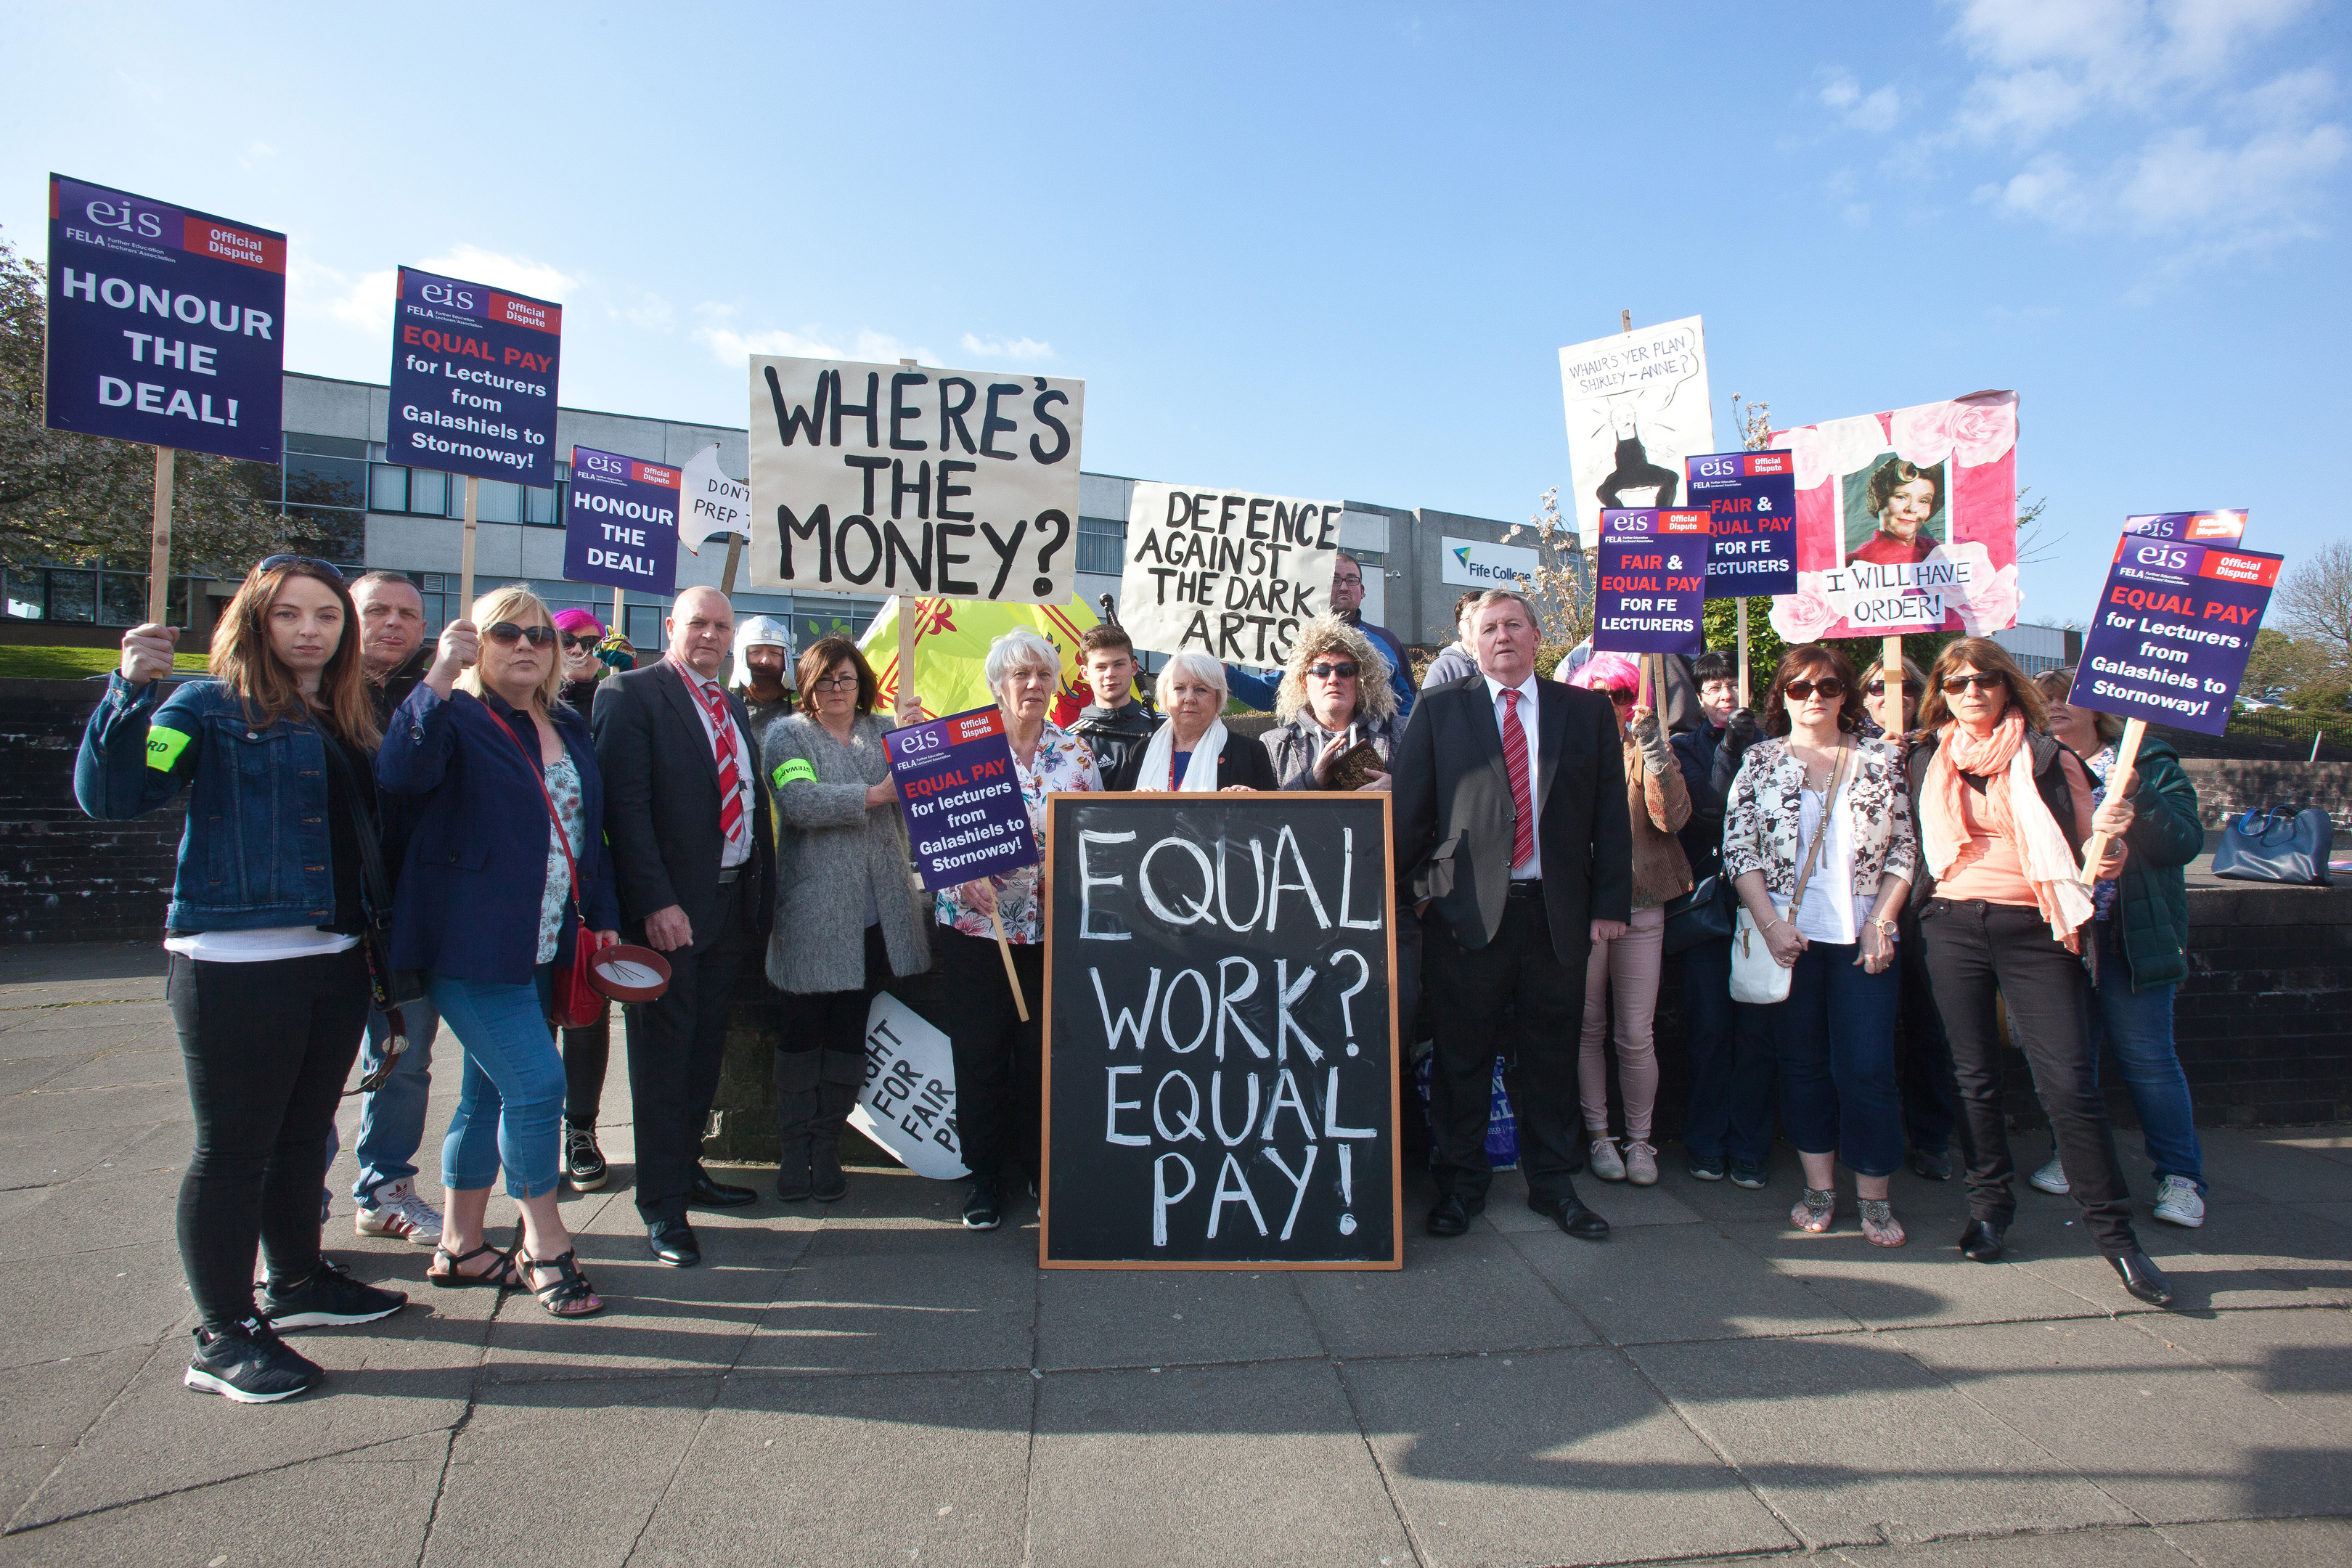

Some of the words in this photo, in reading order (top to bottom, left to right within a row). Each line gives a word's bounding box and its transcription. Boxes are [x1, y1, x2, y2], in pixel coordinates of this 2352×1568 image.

[86, 201, 162, 237] eis
[66, 227, 105, 246] FELA
[107, 237, 130, 246] Further
[132, 242, 164, 254] Education
[211, 229, 262, 251] Official
[139, 250, 176, 263] Association
[209, 240, 263, 264] Dispute
[63, 267, 272, 340] HONOUR
[422, 283, 473, 310] eis
[407, 305, 433, 318] FELA
[507, 310, 545, 327] Dispute
[508, 301, 544, 318] Official
[123, 330, 217, 376] THE
[404, 325, 495, 362] EQUAL
[505, 347, 552, 373] PAY
[1569, 354, 1619, 379] WHAUR'S
[1621, 346, 1649, 364] YER
[1653, 336, 1686, 357] PLAN
[407, 355, 438, 374] for
[445, 362, 547, 397] Lecturers
[99, 375, 238, 427] DEAL!
[452, 388, 502, 412] from
[402, 405, 518, 441] Galashiels
[524, 428, 544, 445] to
[764, 366, 1071, 465] WHERE'S
[412, 433, 534, 469] Stornoway!
[578, 471, 595, 480] FELA
[587, 456, 622, 474] eis
[644, 467, 669, 478] Official
[1700, 458, 1734, 476] eis
[1755, 464, 1782, 473] Dispute
[643, 473, 669, 485] Dispute
[709, 479, 749, 502] DON'T
[844, 454, 976, 522] THE
[574, 491, 674, 526] HONOUR
[694, 499, 738, 523] PREP
[1711, 498, 1752, 514] FAIR
[1757, 497, 1772, 512] &
[1166, 491, 1342, 550] DEFENCE
[1614, 513, 1648, 531] eis
[1708, 520, 1753, 537] QUAL
[1758, 516, 1792, 533] PAY
[2136, 518, 2174, 537] eis
[600, 523, 646, 547] THE
[777, 504, 1070, 600] MONEY?
[1134, 528, 1292, 579] AGAINST
[1715, 541, 1747, 555] FOR
[1751, 540, 1771, 553] FE
[2136, 544, 2188, 569] eis
[587, 547, 655, 576] DEAL!
[1469, 563, 1490, 577] Fife
[1621, 555, 1662, 570] FAIR
[1667, 555, 1683, 571] &
[1706, 559, 1789, 575] ECTURERS
[2119, 567, 2144, 579] FELA
[2216, 566, 2258, 581] Dispute
[2221, 557, 2261, 571] Official
[1601, 576, 1661, 593] EQUAL
[1666, 577, 1702, 592] PAY
[1826, 573, 1845, 592] I
[1851, 565, 1911, 589] WILL
[1916, 562, 1971, 584] HAVE
[1148, 568, 1220, 605] THE
[1225, 576, 1315, 618] DARK
[1620, 597, 1652, 611] FOR
[1657, 598, 1678, 611] FE
[1854, 595, 1940, 623] ORDER!
[2110, 586, 2195, 617] EQUAL
[2202, 602, 2258, 626] PAY
[1601, 618, 1694, 632] LECTURERS
[2105, 611, 2136, 629] for
[2139, 618, 2241, 649] Lecturers
[1177, 610, 1299, 666] ARTS
[2139, 642, 2189, 663] from
[671, 658, 687, 677] Labour
[2091, 656, 2199, 690] Galashiels
[2203, 677, 2227, 695] to
[2092, 679, 2210, 716] Stornoway!
[712, 717, 726, 738] Labour
[960, 716, 989, 730] Official
[962, 724, 992, 739] Dispute
[901, 730, 939, 754] eis
[779, 765, 812, 780] STEWAR
[897, 759, 917, 771] FELA
[905, 770, 968, 799] EQUAL
[971, 758, 1005, 781] PAY
[911, 802, 939, 817] for
[938, 782, 1012, 811] lecturers
[947, 809, 987, 828] from
[920, 823, 1005, 856] Galashiels
[1007, 819, 1025, 831] to
[932, 836, 1022, 873] Stornoway!
[1079, 825, 1382, 940] EQUAL
[1089, 949, 1370, 1065] WORK?
[872, 1059, 925, 1120] FOR
[900, 1079, 955, 1143] FAIR
[1105, 1067, 1377, 1146] EQUAL
[934, 1109, 960, 1153] PA
[1153, 1144, 1357, 1246] PAY!
